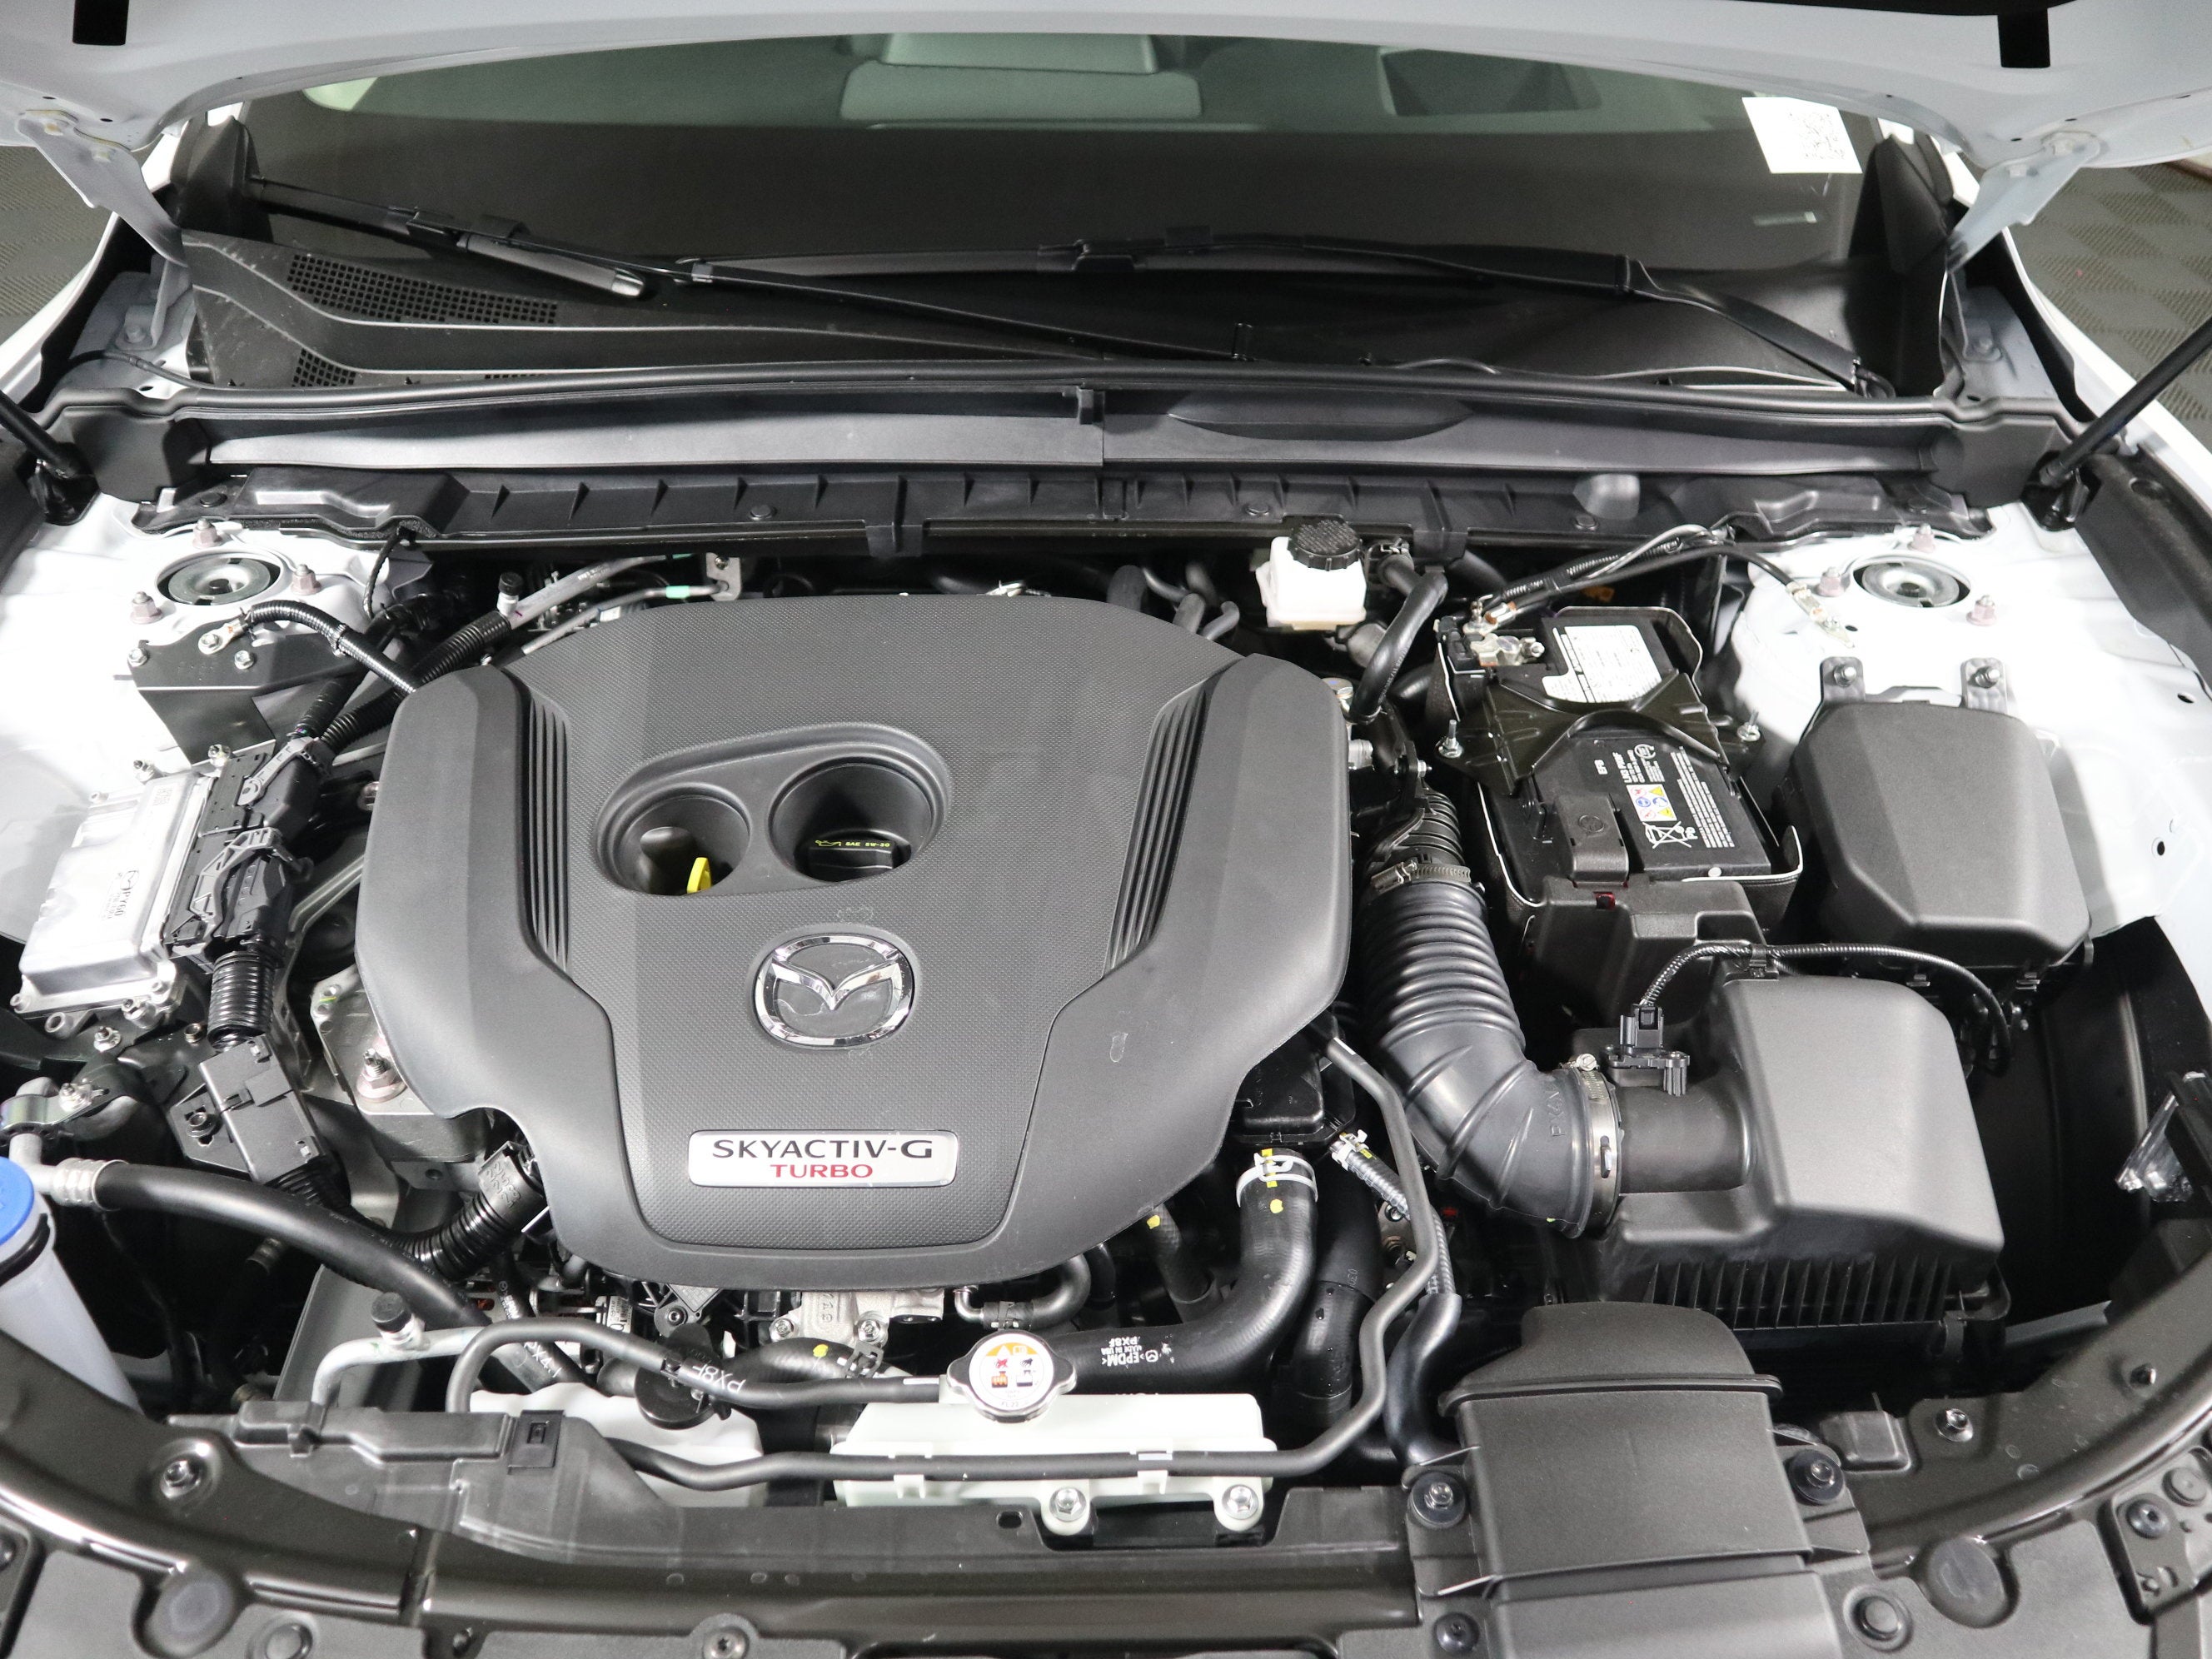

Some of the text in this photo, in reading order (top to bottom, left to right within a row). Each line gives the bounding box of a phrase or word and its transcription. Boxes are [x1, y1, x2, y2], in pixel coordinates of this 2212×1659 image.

[712, 1139, 933, 1158] SKYACTIV-G
[770, 1163, 873, 1178] TURBO
[1108, 1336, 1138, 1348] PX8F
[686, 1363, 746, 1393] PX8F
